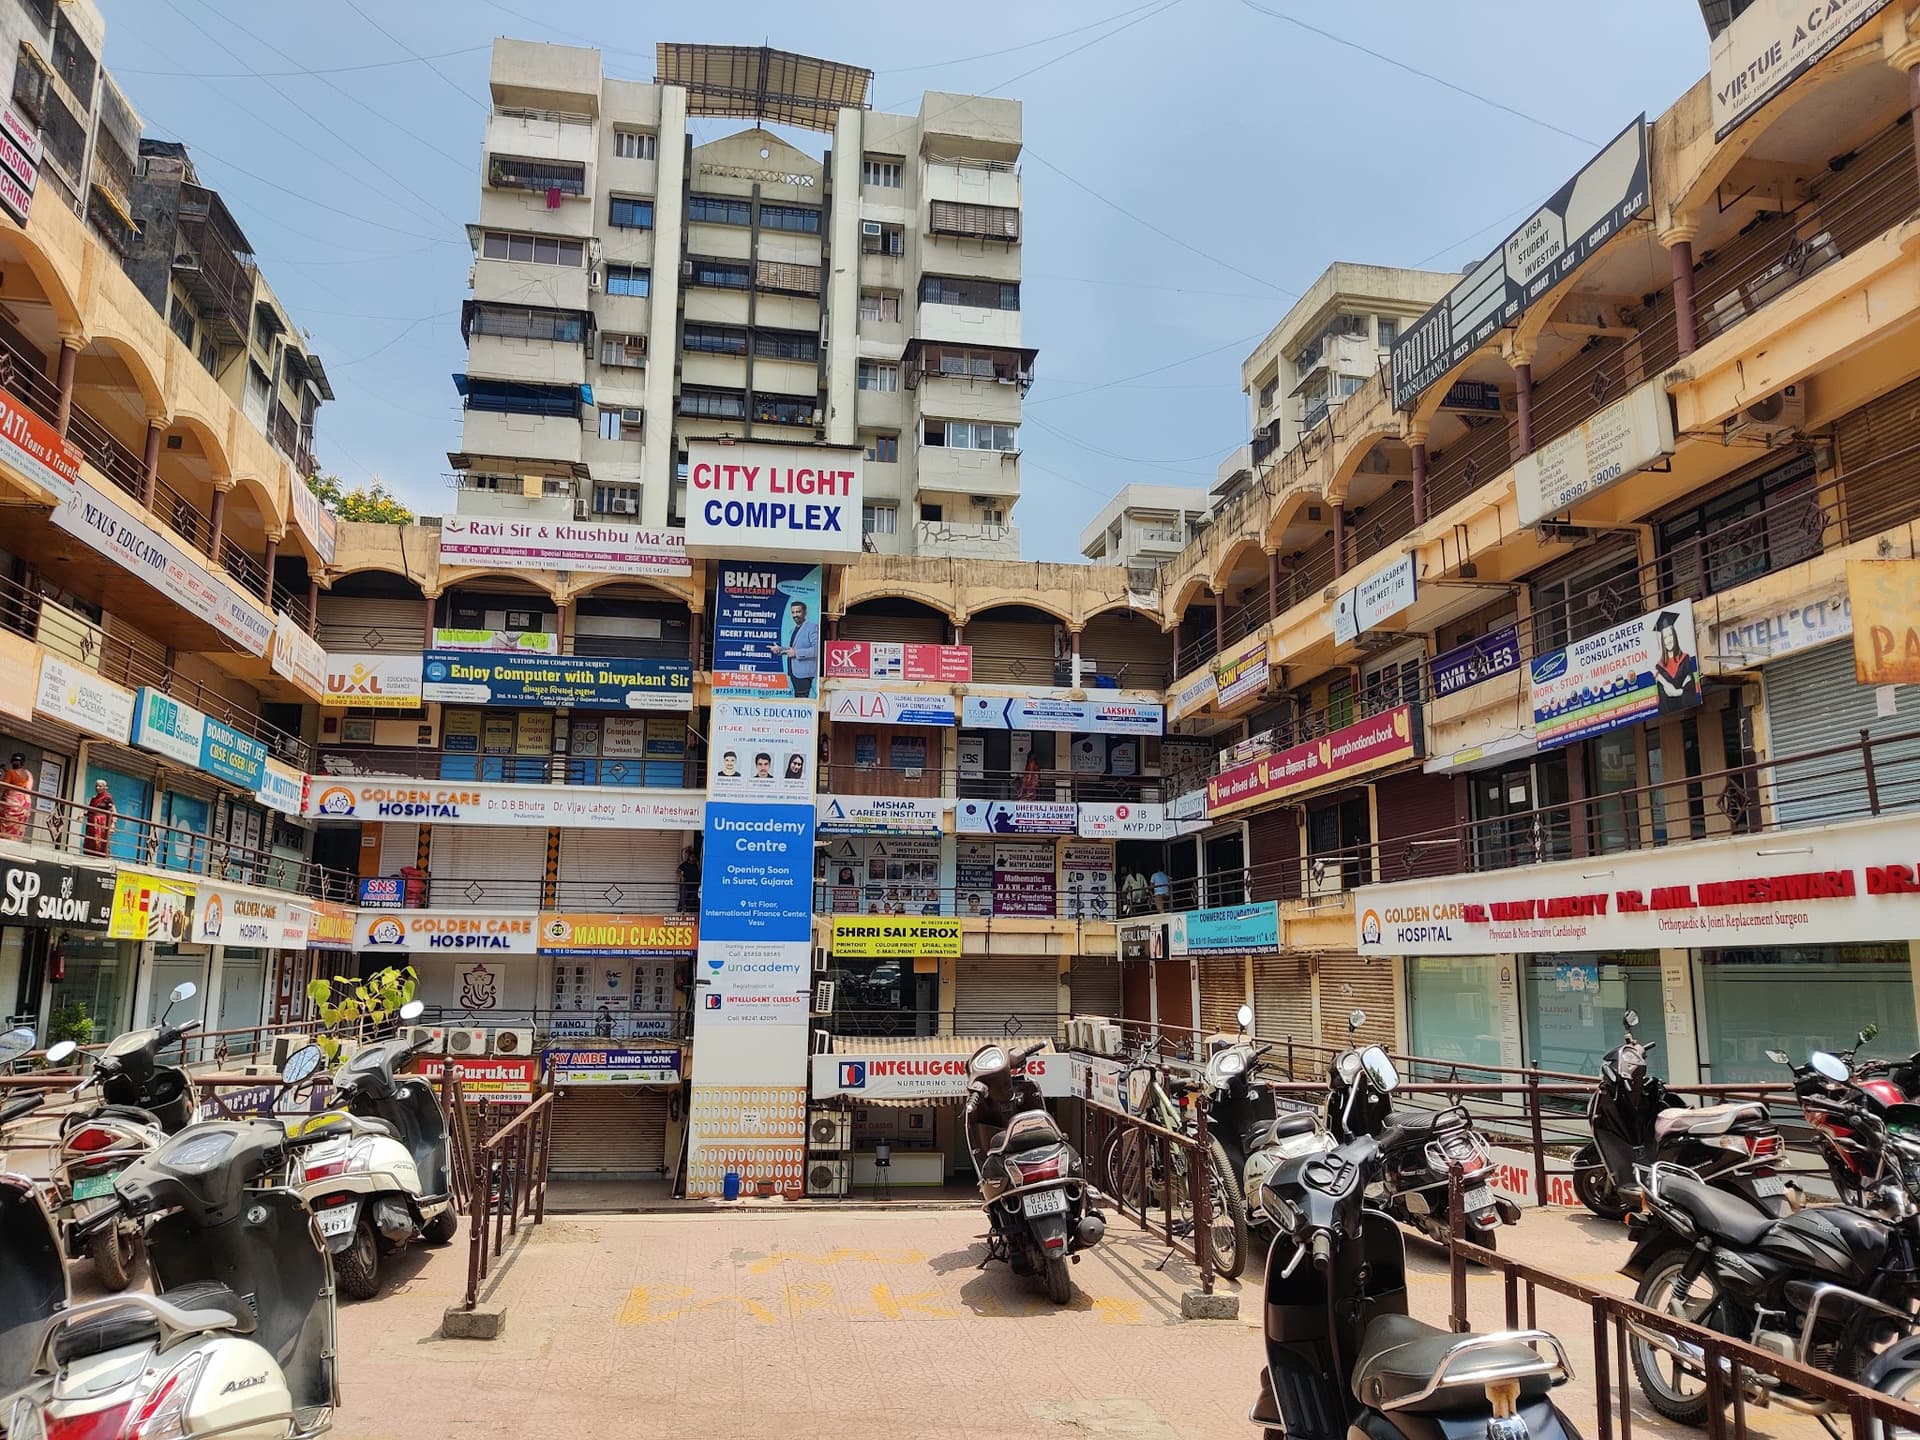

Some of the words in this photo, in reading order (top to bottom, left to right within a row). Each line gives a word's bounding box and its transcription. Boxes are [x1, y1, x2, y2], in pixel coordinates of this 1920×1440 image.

[1808, 28, 1849, 66] Specialist
[1717, 40, 1782, 107] VIRTUE
[1731, 95, 1751, 112] Make
[1525, 218, 1542, 239] VISA
[1518, 229, 1550, 264] STUDENT
[1476, 320, 1495, 341] TOEFL
[1505, 300, 1519, 318] GRE
[1530, 274, 1550, 297] GMAT
[1561, 251, 1575, 271] CAT
[1589, 220, 1611, 247] CMAT
[1623, 192, 1643, 218] CLAT
[1524, 241, 1560, 278] INVESTOR
[1399, 352, 1450, 405] CONSULTANCY
[25, 433, 45, 458] Tours
[52, 453, 79, 481] Travels
[693, 463, 760, 492] CITY
[770, 468, 855, 497] LIGHT
[1560, 480, 1588, 505] 98982
[1591, 463, 1621, 488] 59006
[704, 500, 842, 532] COMPLEX
[81, 502, 117, 537] NEXUS
[116, 527, 168, 574] EDUCATION
[469, 521, 504, 537] Ravi
[511, 523, 531, 538] Sir
[538, 527, 549, 539] &
[556, 526, 628, 543] Khushbu
[724, 571, 777, 589] BHATI
[1361, 579, 1382, 597] TRINITY
[1382, 561, 1409, 583] ACADEMY
[1366, 595, 1377, 608] FOR
[1376, 588, 1390, 602] NEET
[744, 610, 777, 619] Chemistry
[744, 630, 778, 639] SYLLABUS
[1575, 637, 1606, 656] ABROAD
[1608, 622, 1644, 644] CAREER
[830, 646, 860, 667] SK
[1580, 637, 1641, 667] CONSULTANTS
[537, 658, 549, 666] FOR
[550, 659, 583, 667] COMPUTER
[451, 664, 489, 681] Enjoy
[494, 667, 560, 685] Computer
[565, 669, 594, 684] with
[599, 672, 666, 688] Divyakant
[671, 673, 689, 687] Sir
[1218, 666, 1237, 689] SONI
[1440, 665, 1466, 692] AVM
[1533, 684, 1554, 699] WORK
[1560, 674, 1584, 691] STUDY
[1590, 650, 1648, 678] IMMIGRATION
[733, 706, 760, 717] NEXUS
[764, 707, 812, 719] EDUCATION
[1102, 705, 1137, 717] LAKSHYA
[175, 724, 200, 748] Science
[606, 728, 642, 737] Computer
[780, 727, 809, 735] BOARDS
[206, 722, 234, 745] BOARDS
[236, 734, 253, 752] NEET
[254, 744, 264, 762] JEE
[615, 738, 631, 746] with
[1332, 740, 1351, 764] punjab
[1351, 731, 1377, 753] national
[1377, 724, 1393, 742] bank
[210, 743, 227, 763] CBSE
[229, 752, 245, 771] GSEB
[361, 788, 431, 804] GOLDEN
[436, 790, 481, 806] CARE
[518, 801, 545, 812] Bhutra
[553, 802, 564, 812] Dr.
[566, 802, 586, 815] Vijay
[588, 803, 616, 814] Lahoty
[621, 803, 632, 814] Dr.
[635, 804, 651, 814] Anil
[653, 805, 700, 817] Maheshwari
[379, 803, 460, 818] HOSPITAL
[872, 801, 915, 809] IMSHAR
[1015, 804, 1047, 812] DHEERAJ
[1048, 805, 1075, 813] KUMAR
[849, 809, 888, 817] CAREER
[890, 810, 937, 819] INSTITUTE
[1042, 812, 1074, 821] ACADEMY
[1083, 815, 1101, 824] LUV
[1102, 815, 1115, 824] SIR
[1137, 810, 1147, 819] IB
[714, 817, 805, 836] Unacademy
[1123, 822, 1162, 833] MYP/DP
[736, 838, 787, 852] Centre
[728, 865, 765, 875] Opening
[767, 866, 789, 874] Soon
[1004, 874, 1045, 883] Mathematics
[368, 880, 396, 893] SNS
[722, 877, 730, 885] in
[733, 877, 758, 886] Surat,
[760, 878, 794, 887] Gujarat
[1, 868, 41, 917] SP
[1384, 906, 1431, 924] GOLDEN
[1433, 902, 1465, 922] CARE
[1464, 904, 1490, 923] DR.
[1489, 899, 1536, 922] VIJAY
[1536, 893, 1609, 919] LAHOTY
[1616, 890, 1649, 913] DR.
[1650, 885, 1698, 911] ANIL
[1696, 869, 1857, 907] MAHESHWARI
[1865, 864, 1914, 895] DR.
[38, 895, 88, 923] SALON
[233, 899, 261, 917] GOLDEN
[260, 903, 277, 920] CARE
[1199, 909, 1226, 923] COMMERCE
[239, 922, 269, 942] HOSPITAL
[411, 919, 481, 933] GOLDEN
[487, 919, 532, 934] CARE
[836, 927, 880, 938] SHRRI
[883, 927, 907, 938] SAI
[909, 927, 959, 939] XEROX
[1397, 926, 1453, 943] HOSPITAL
[1489, 927, 1513, 941] Physician
[1518, 926, 1552, 939] Non-Invasive
[1552, 924, 1588, 941] Cardiologist
[1658, 917, 1700, 934] Orthopaedic
[1700, 918, 1707, 929] &
[1707, 914, 1726, 931] Joint
[1725, 912, 1775, 931] Replacement
[1774, 910, 1810, 931] Surgeon
[430, 935, 510, 948] HOSPITAL
[574, 926, 625, 946] MANOJ
[630, 926, 693, 946] CLASSES
[727, 962, 801, 975] unacademy
[555, 1020, 587, 1029] MANOJ
[636, 1021, 666, 1029] MANOJ
[571, 1052, 607, 1065] AMBE
[609, 1055, 641, 1064] LINING
[643, 1055, 672, 1064] WORK
